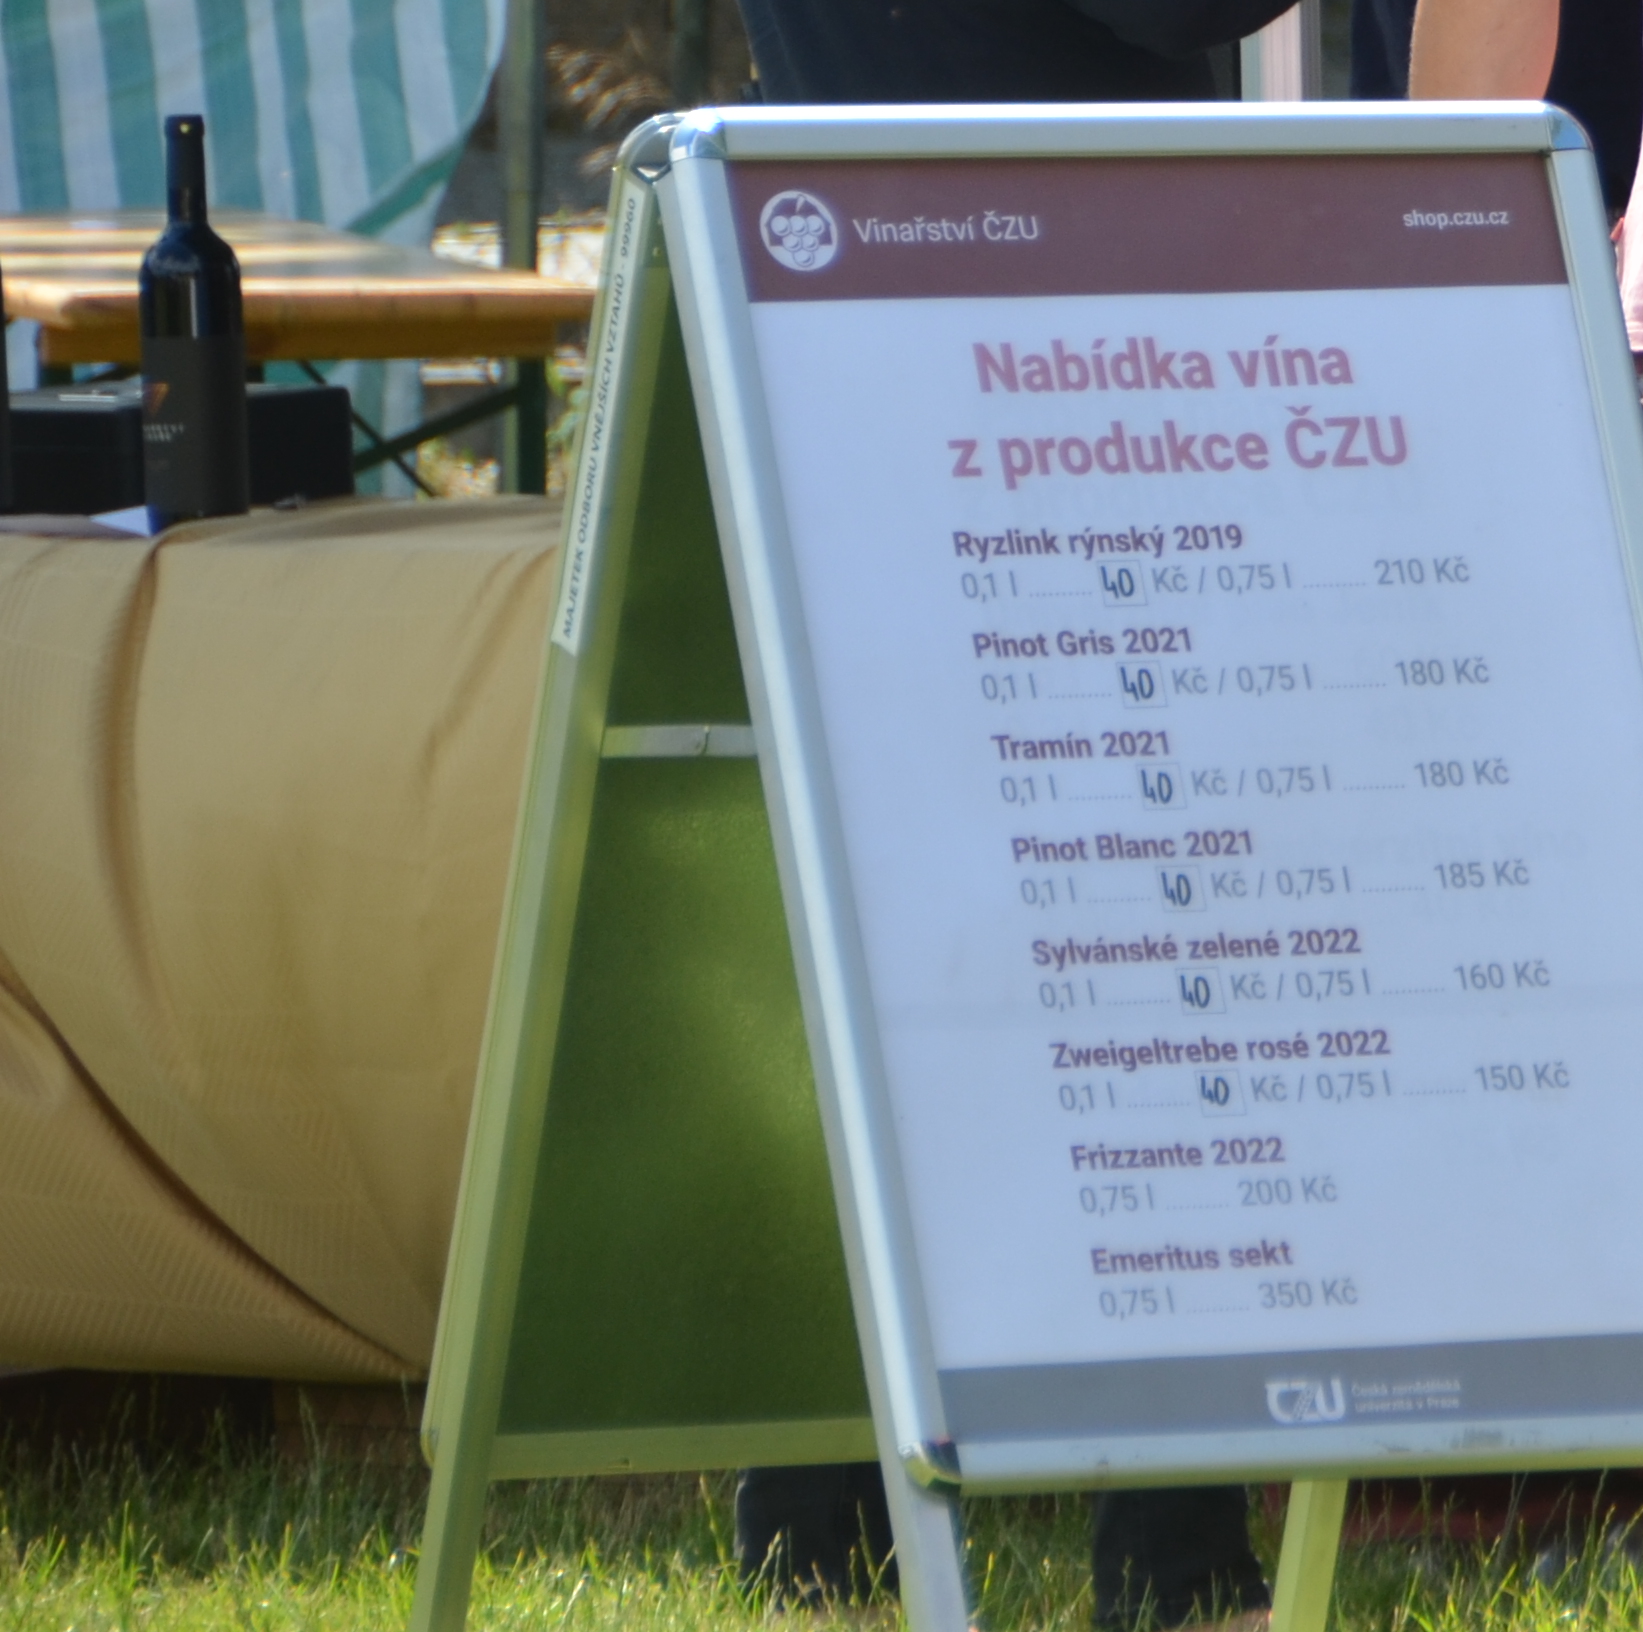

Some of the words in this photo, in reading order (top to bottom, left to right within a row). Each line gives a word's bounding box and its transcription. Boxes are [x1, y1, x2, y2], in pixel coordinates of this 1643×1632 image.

[853, 215, 975, 246] Vinařství
[982, 210, 1040, 243] ČZU
[1402, 208, 1509, 230] shop.czu.cz
[973, 336, 1216, 395] Nabídka
[1228, 334, 1354, 389] vína
[562, 547, 585, 640] MAJETEK
[576, 455, 598, 543] ODBORU
[590, 357, 613, 452] VNĚJŠÍCH
[604, 272, 625, 355] VZTAHŮ
[619, 197, 637, 259] 99960
[946, 438, 983, 478] z
[998, 420, 1269, 490] produkce
[1284, 405, 1409, 470] ČZU
[953, 528, 1060, 563] Ryzlink
[1068, 524, 1165, 560] rýnský
[1173, 523, 1244, 552] 2019
[960, 571, 998, 604] 0,1
[1101, 564, 1136, 600] 40
[1151, 564, 1189, 594] Kč
[1216, 563, 1276, 595] 0,75
[1373, 558, 1425, 586] 210
[1433, 555, 1471, 583] Kč
[972, 630, 1050, 659] Pinot
[1056, 629, 1116, 657] Gris
[1122, 626, 1193, 654] 2021
[980, 673, 1018, 704] 0,1
[1119, 665, 1155, 702] 40
[1171, 666, 1209, 695] Kč
[1236, 665, 1296, 697] 0,75
[1394, 659, 1446, 687] 180
[1453, 656, 1491, 685] Kč
[990, 732, 1094, 762] Tramín
[1100, 730, 1171, 758] 2021
[1000, 775, 1038, 808] 0,1
[1139, 768, 1174, 805] 40
[1190, 769, 1229, 798] Kč
[1255, 767, 1315, 799] 0,75
[1413, 760, 1465, 789] 180
[1473, 757, 1511, 787] Kč
[1010, 835, 1089, 865] Pinot
[1095, 832, 1177, 861] Blanc
[1183, 829, 1254, 858] 2021
[1020, 877, 1058, 910] 0,1
[1159, 869, 1193, 908] 40
[1210, 871, 1249, 899] Kč
[1275, 868, 1336, 900] 0,75
[1433, 862, 1486, 890] 185
[1493, 858, 1531, 888] Kč
[1031, 934, 1179, 972] Sylvánské
[1186, 929, 1281, 961] zelené
[1287, 928, 1362, 956] 2022
[1038, 981, 1077, 1013] 0,1
[1178, 973, 1212, 1011] 40
[1229, 974, 1269, 1004] Kč
[1295, 971, 1356, 1004] 0,75
[1452, 964, 1506, 992] 160
[1513, 960, 1552, 990] Kč
[1049, 1037, 1239, 1073] Zweigeltrebe
[1246, 1031, 1310, 1061] rosé
[1316, 1029, 1391, 1058] 2022
[1058, 1082, 1097, 1114] 0,1
[1200, 1074, 1231, 1108] 40
[1250, 1075, 1288, 1104] Kč
[1315, 1072, 1376, 1105] 0,75
[1473, 1065, 1526, 1093] 150
[1533, 1061, 1571, 1091] Kč
[1069, 1141, 1204, 1172] Frizzante
[1209, 1137, 1287, 1166] 2022
[1078, 1185, 1140, 1218] 0,75
[1237, 1179, 1293, 1207] 200
[1300, 1174, 1339, 1204] Kč
[1090, 1244, 1222, 1276] Emeritus
[1228, 1240, 1294, 1270] sekt
[1098, 1289, 1158, 1322] 0,75
[1257, 1281, 1314, 1310] 350
[1320, 1277, 1359, 1307] Kč
